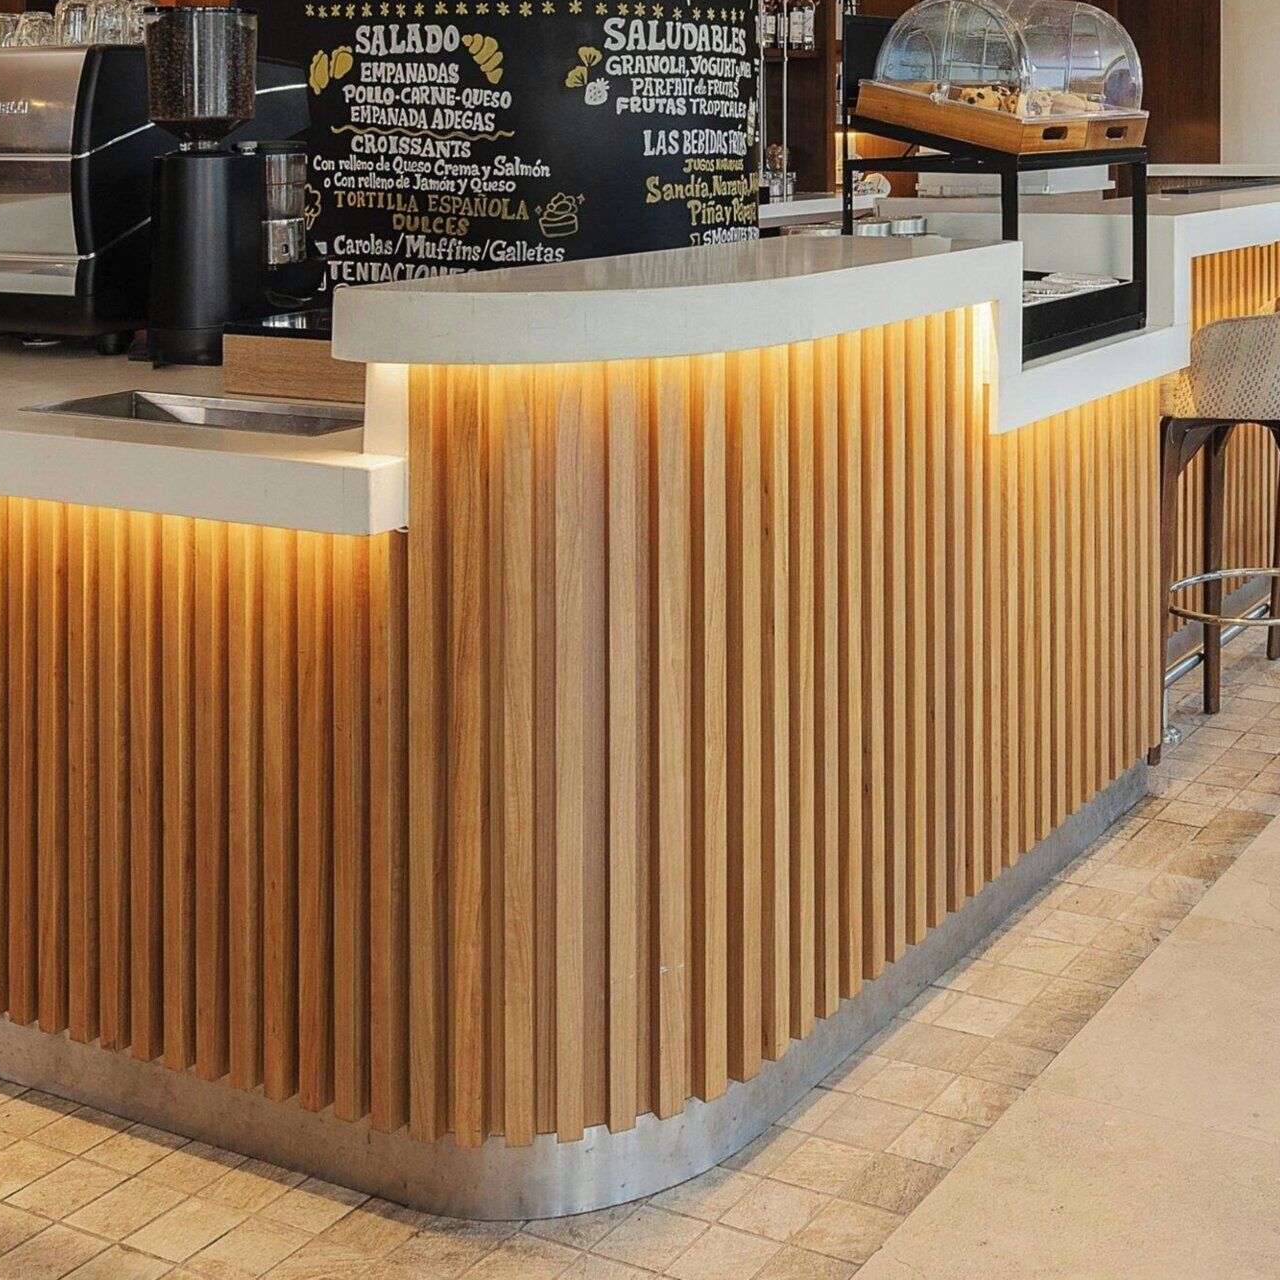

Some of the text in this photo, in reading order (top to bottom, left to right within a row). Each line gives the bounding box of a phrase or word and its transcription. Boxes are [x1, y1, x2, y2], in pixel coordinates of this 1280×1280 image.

[355, 23, 460, 56] SALADO
[603, 17, 747, 56] SALUDABLES
[360, 61, 460, 84] EMPANADAS
[605, 54, 690, 78] GRANOLA,
[689, 55, 736, 77] YOGURT
[631, 77, 740, 99] PARFAIT de FRUTAS
[350, 106, 496, 132] EMPANADA ADEGAS
[616, 96, 747, 119] FRUTAS TROPICALES
[350, 133, 471, 159] CROISSANTS
[643, 129, 680, 157] LAS
[682, 128, 728, 155] BEBIDAS
[313, 154, 551, 180] Con relleno de Queso Crema y Salmón
[683, 157, 715, 173] JUGOS
[323, 172, 517, 195] o Con relleno de Jamón y Queso
[645, 174, 713, 204] Sandía,
[333, 190, 530, 221] TORTILLA ESPAÑOLA
[686, 200, 725, 226] Piña
[724, 206, 732, 226] y
[392, 213, 471, 237] DULCES
